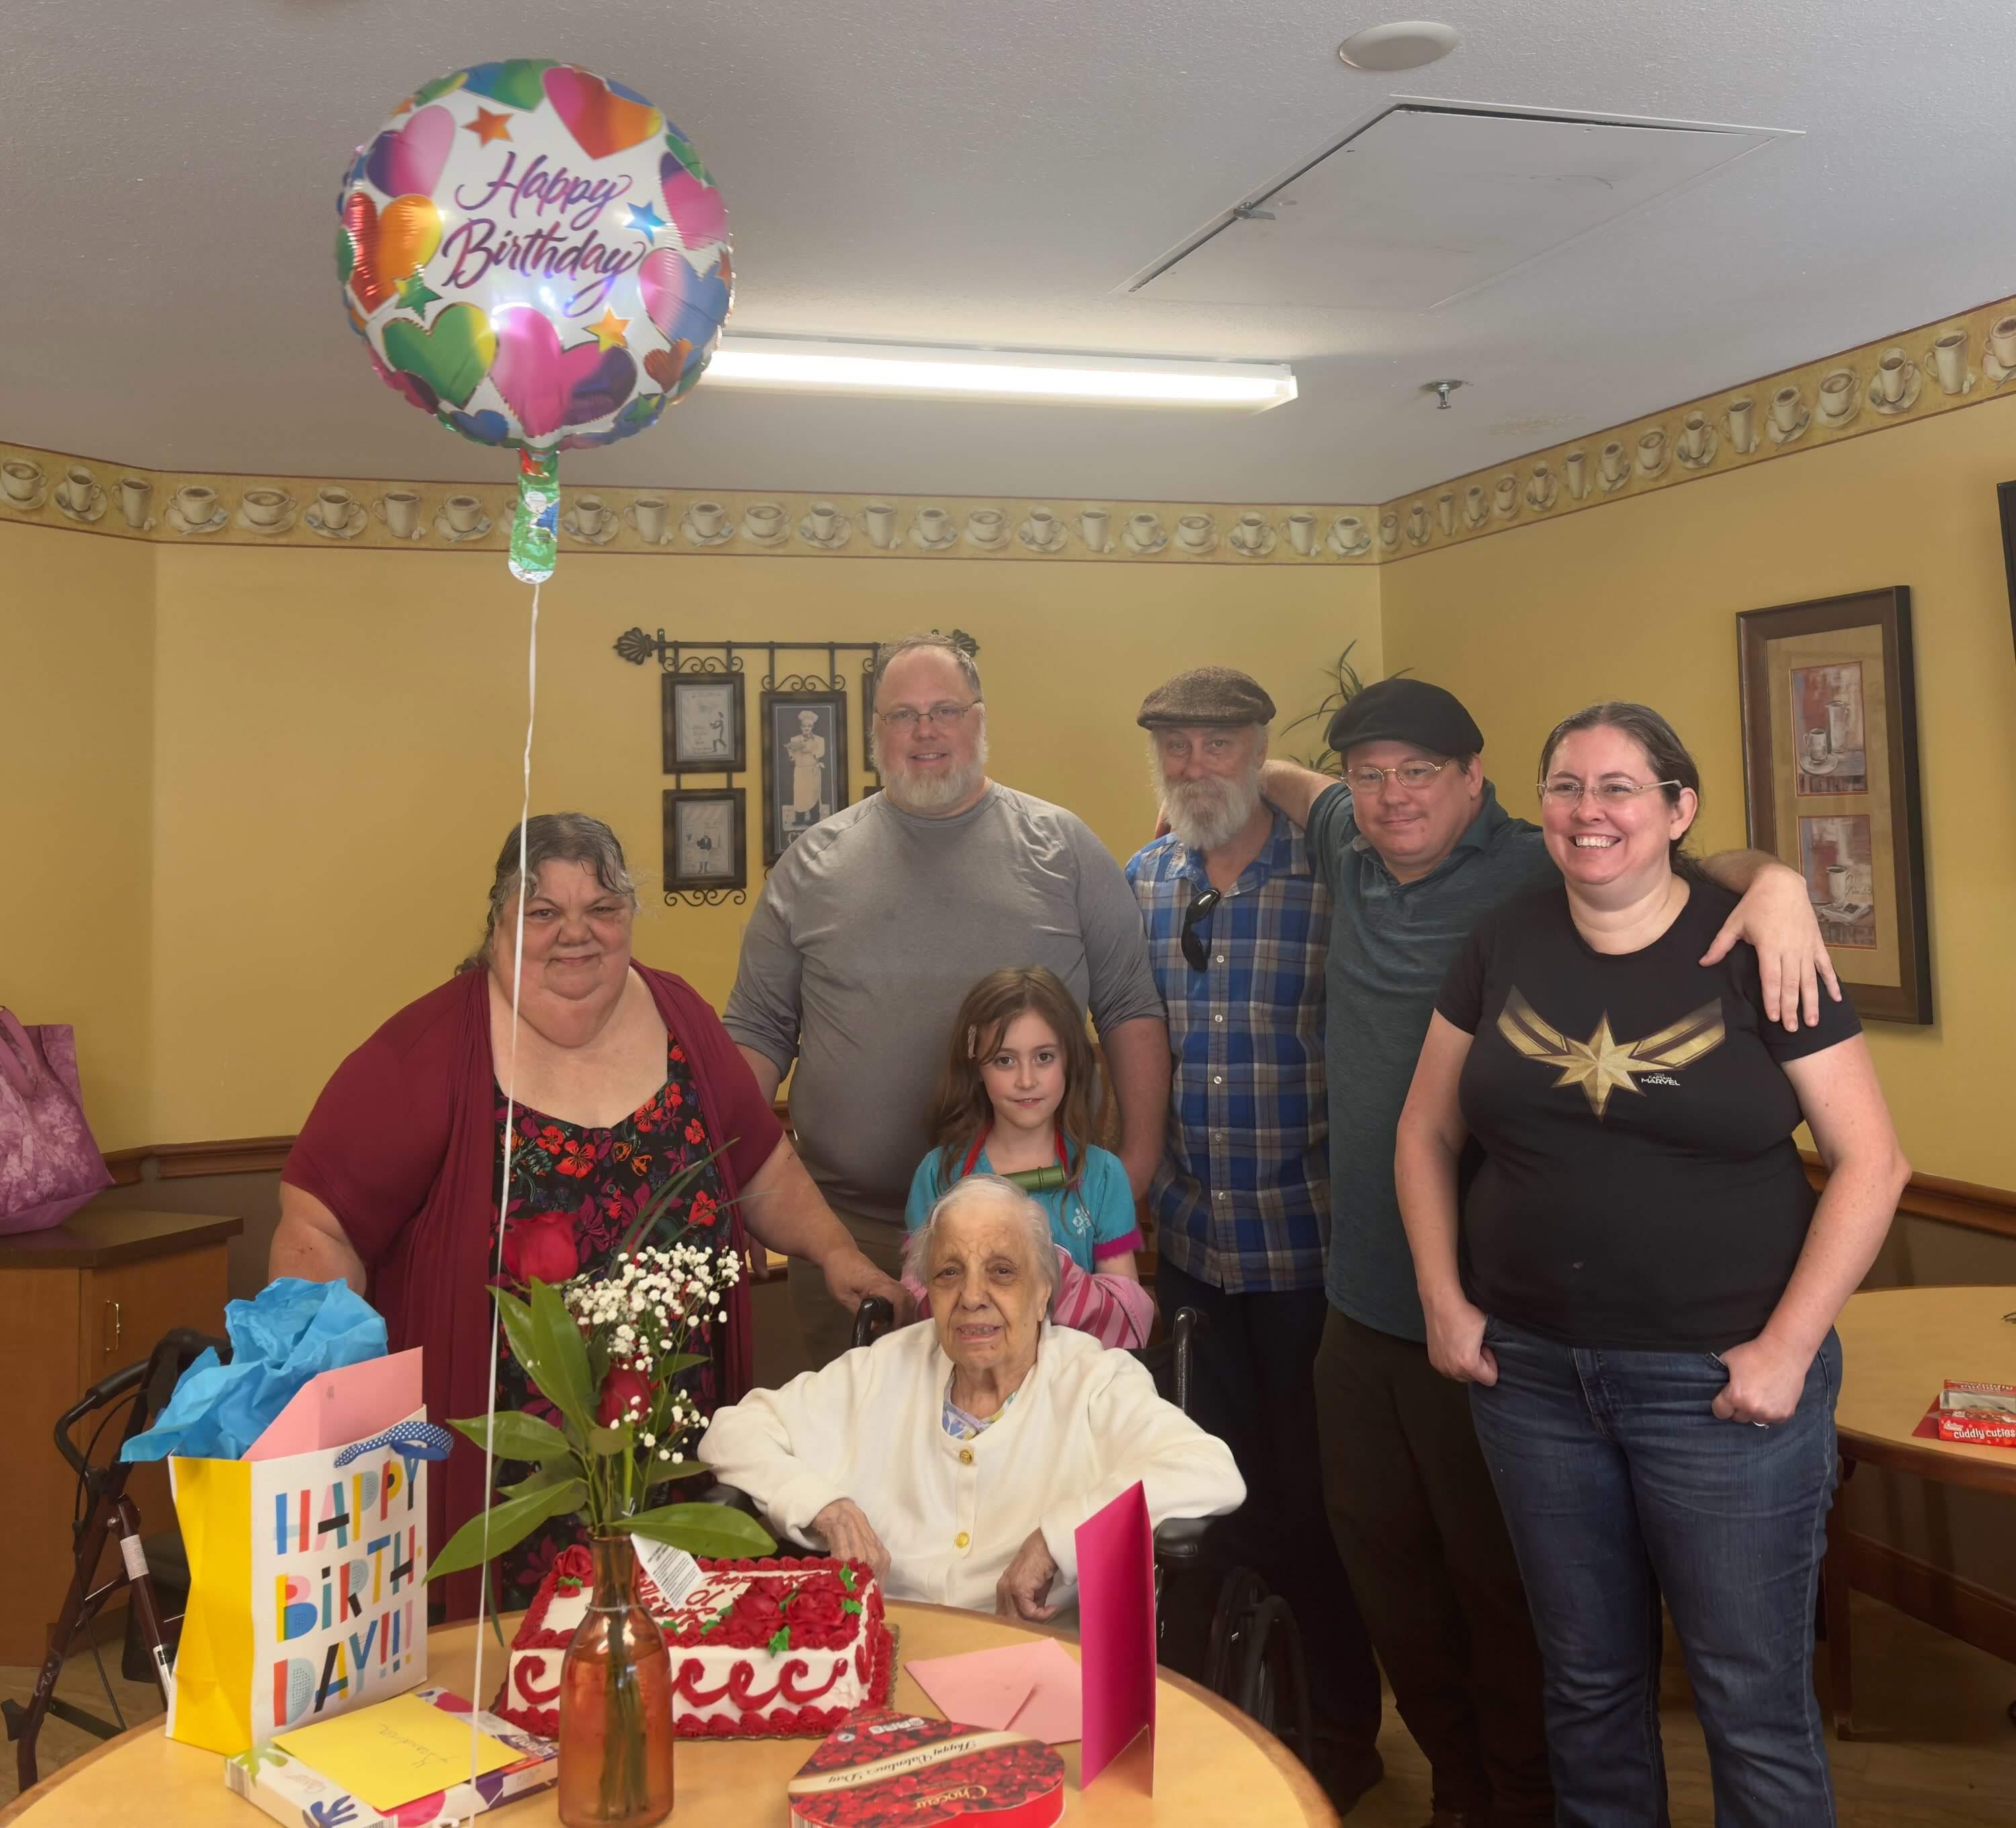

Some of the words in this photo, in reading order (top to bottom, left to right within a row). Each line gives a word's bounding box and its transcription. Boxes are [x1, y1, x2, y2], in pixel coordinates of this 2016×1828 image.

[454, 151, 633, 231] Happy
[440, 217, 646, 319] Birthday
[1640, 1077, 1681, 1086] MARVEL
[1954, 1428, 1985, 1440] cuddly
[273, 1456, 421, 1555] HAPPY
[274, 1600, 413, 1728] DAY!!!
[933, 1740, 976, 1756] Happy
[828, 1774, 863, 1784] Day
[915, 1784, 988, 1811] Choceur
